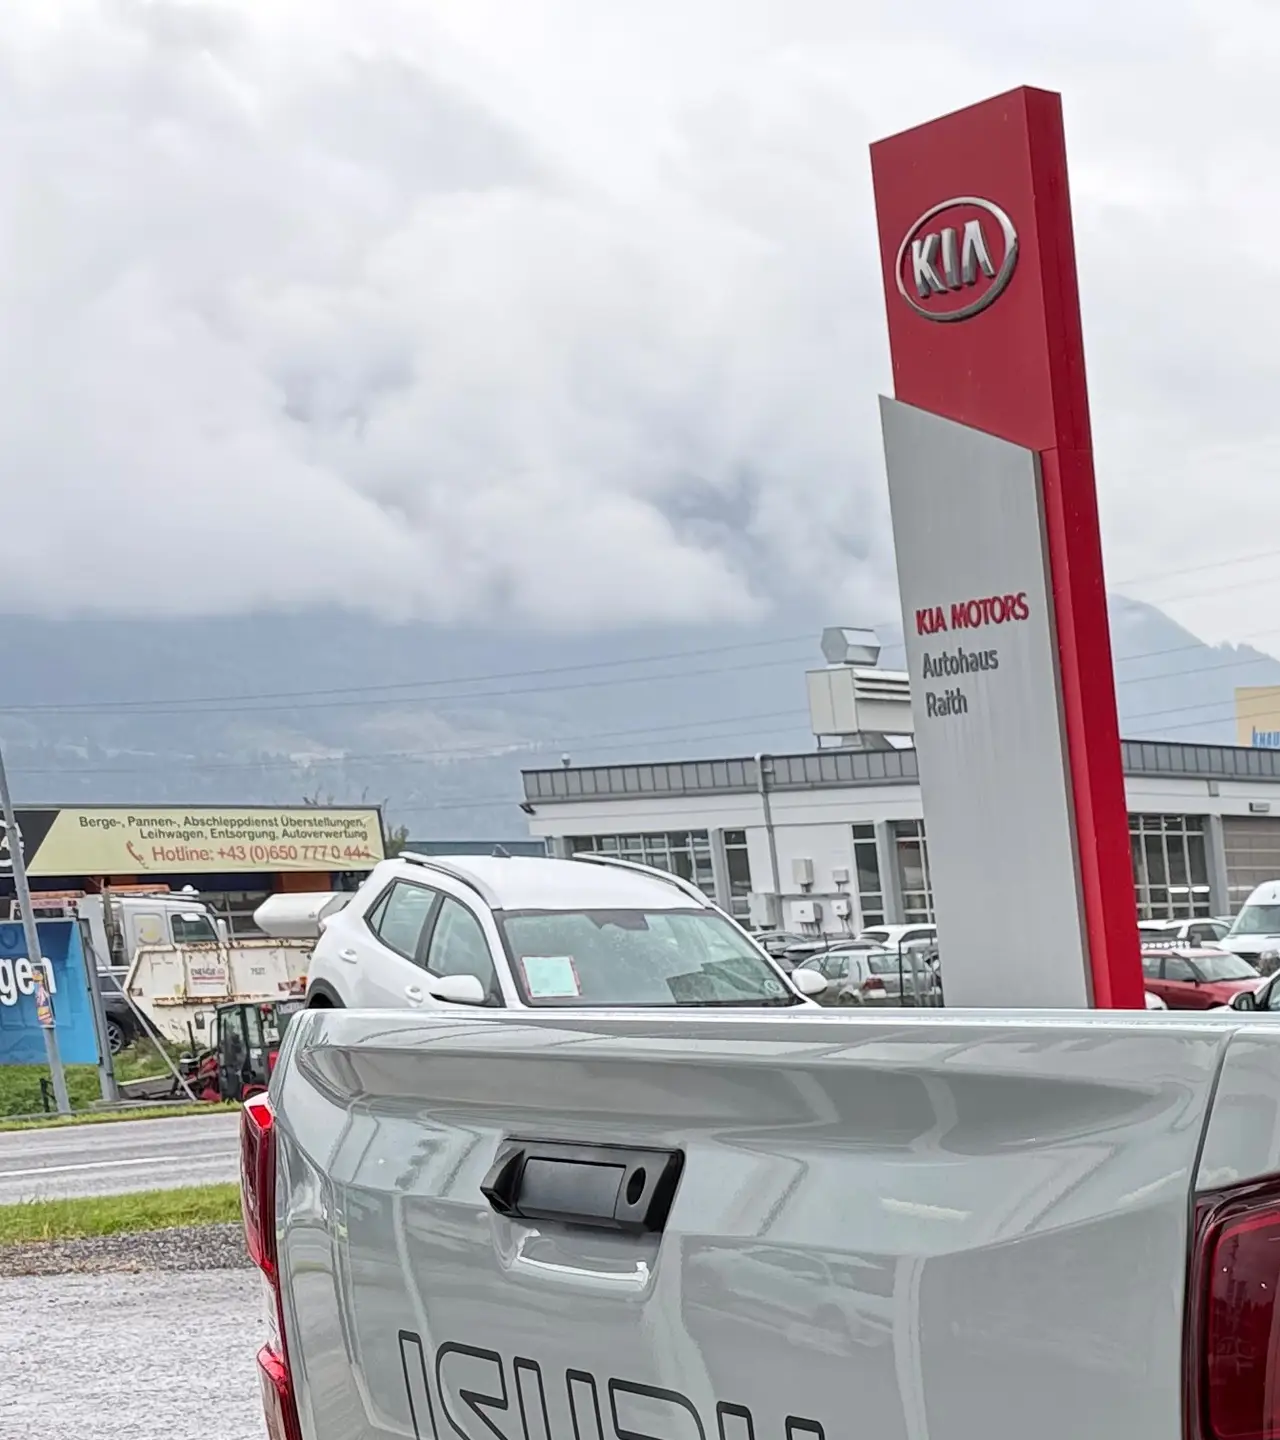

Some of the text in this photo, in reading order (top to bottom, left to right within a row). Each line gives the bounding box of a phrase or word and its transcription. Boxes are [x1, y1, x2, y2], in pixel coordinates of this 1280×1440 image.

[911, 219, 996, 298] KIA
[916, 592, 1029, 635] KIA MOTORS
[923, 647, 999, 679] Autohaus
[926, 687, 968, 717] Raith
[183, 816, 279, 829] Abschleppdienst
[282, 829, 368, 841] Autoverwertung
[152, 846, 215, 862] Hotline:
[217, 846, 246, 861] +43
[250, 845, 298, 864] (0)650
[301, 846, 328, 860] 777
